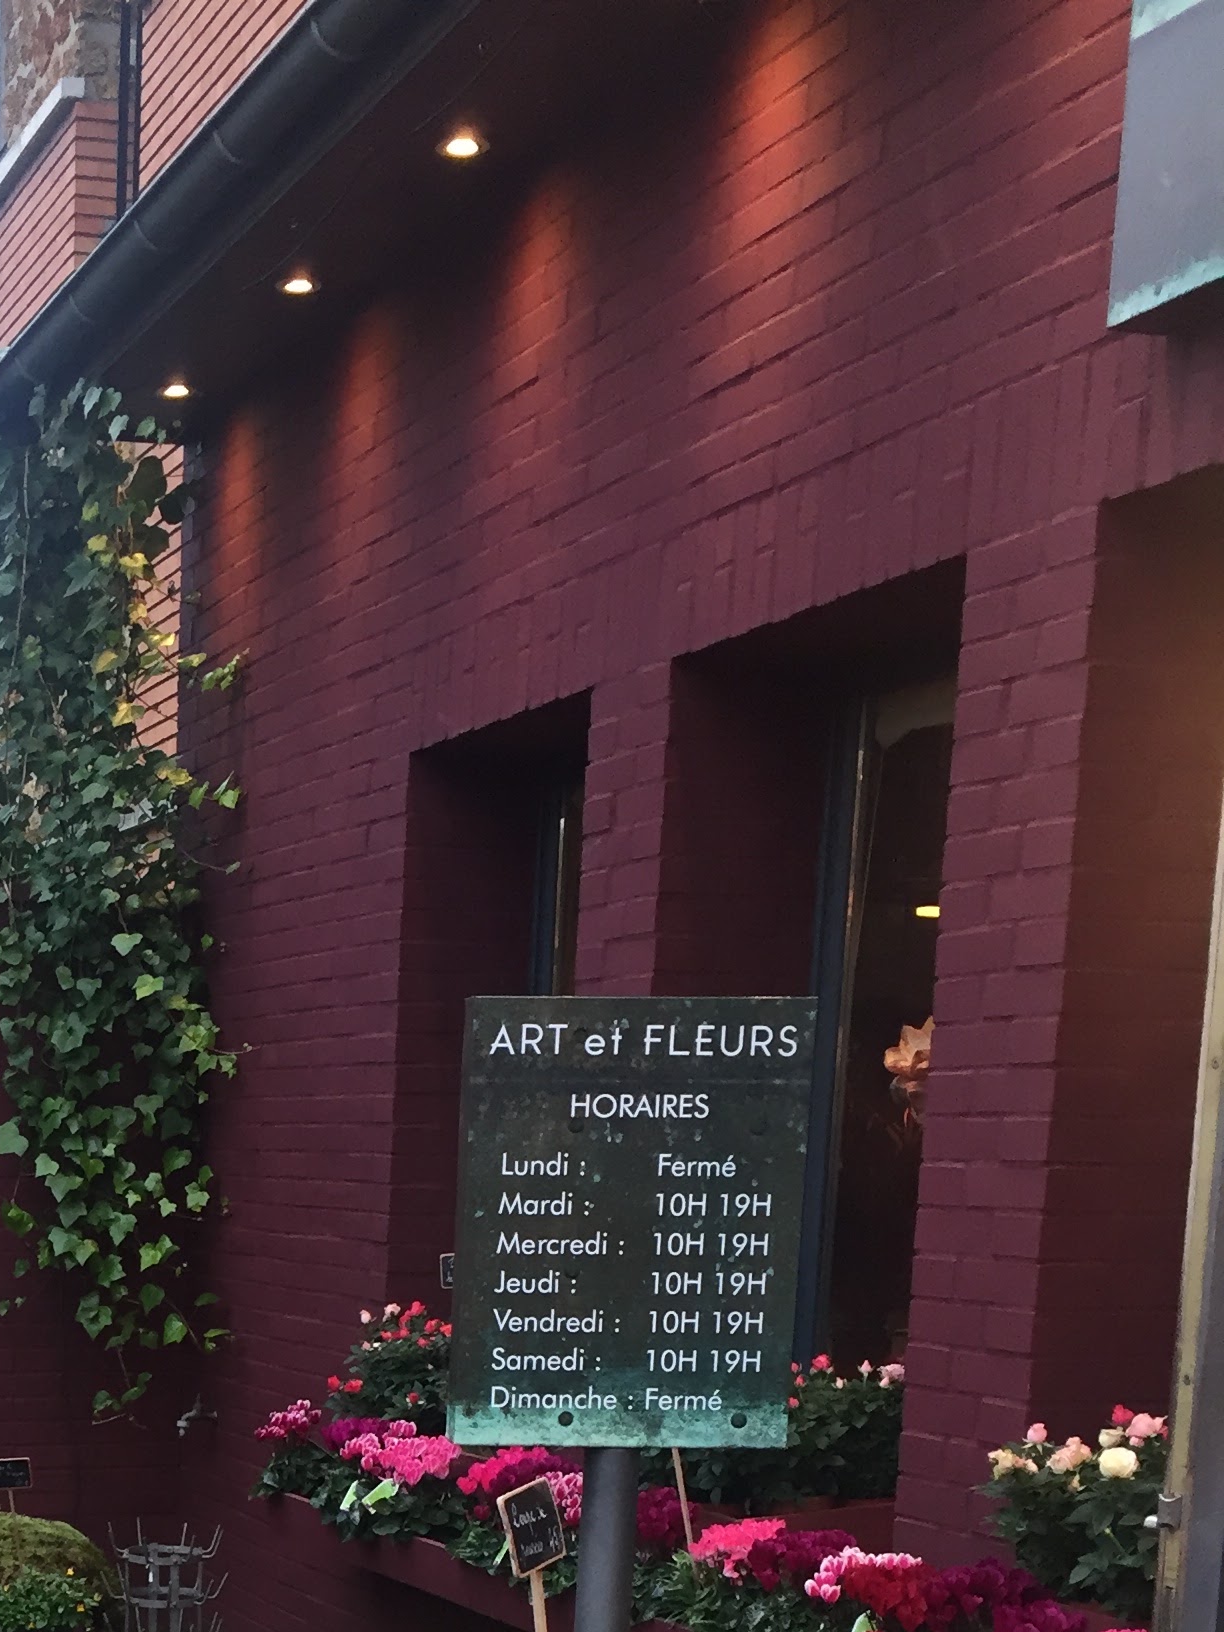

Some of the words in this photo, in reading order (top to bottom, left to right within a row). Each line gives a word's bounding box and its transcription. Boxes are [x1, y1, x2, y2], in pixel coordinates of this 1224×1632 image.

[489, 1023, 569, 1055] ART
[584, 1026, 623, 1056] et
[643, 1024, 798, 1057] FLEURS
[570, 1093, 710, 1119] HORAIRES
[501, 1151, 569, 1177] Lundi
[657, 1153, 737, 1178] Fermé
[497, 1191, 573, 1216] Mardi
[655, 1192, 707, 1217] 10H
[720, 1193, 772, 1218] 19H
[495, 1230, 608, 1256] Mercredi
[653, 1232, 705, 1256] 10H
[717, 1232, 769, 1257] 19H
[493, 1269, 561, 1294] Jeudi
[651, 1271, 703, 1295] 10H
[715, 1272, 767, 1296] 19H
[492, 1308, 604, 1333] Vendredi
[649, 1310, 700, 1334] 10H
[713, 1310, 764, 1335] 19H
[491, 1347, 585, 1372] Samedi
[646, 1349, 698, 1373] 10H
[710, 1349, 762, 1374] 19H
[490, 1385, 618, 1411] Dimanche
[645, 1387, 723, 1412] Fermé
